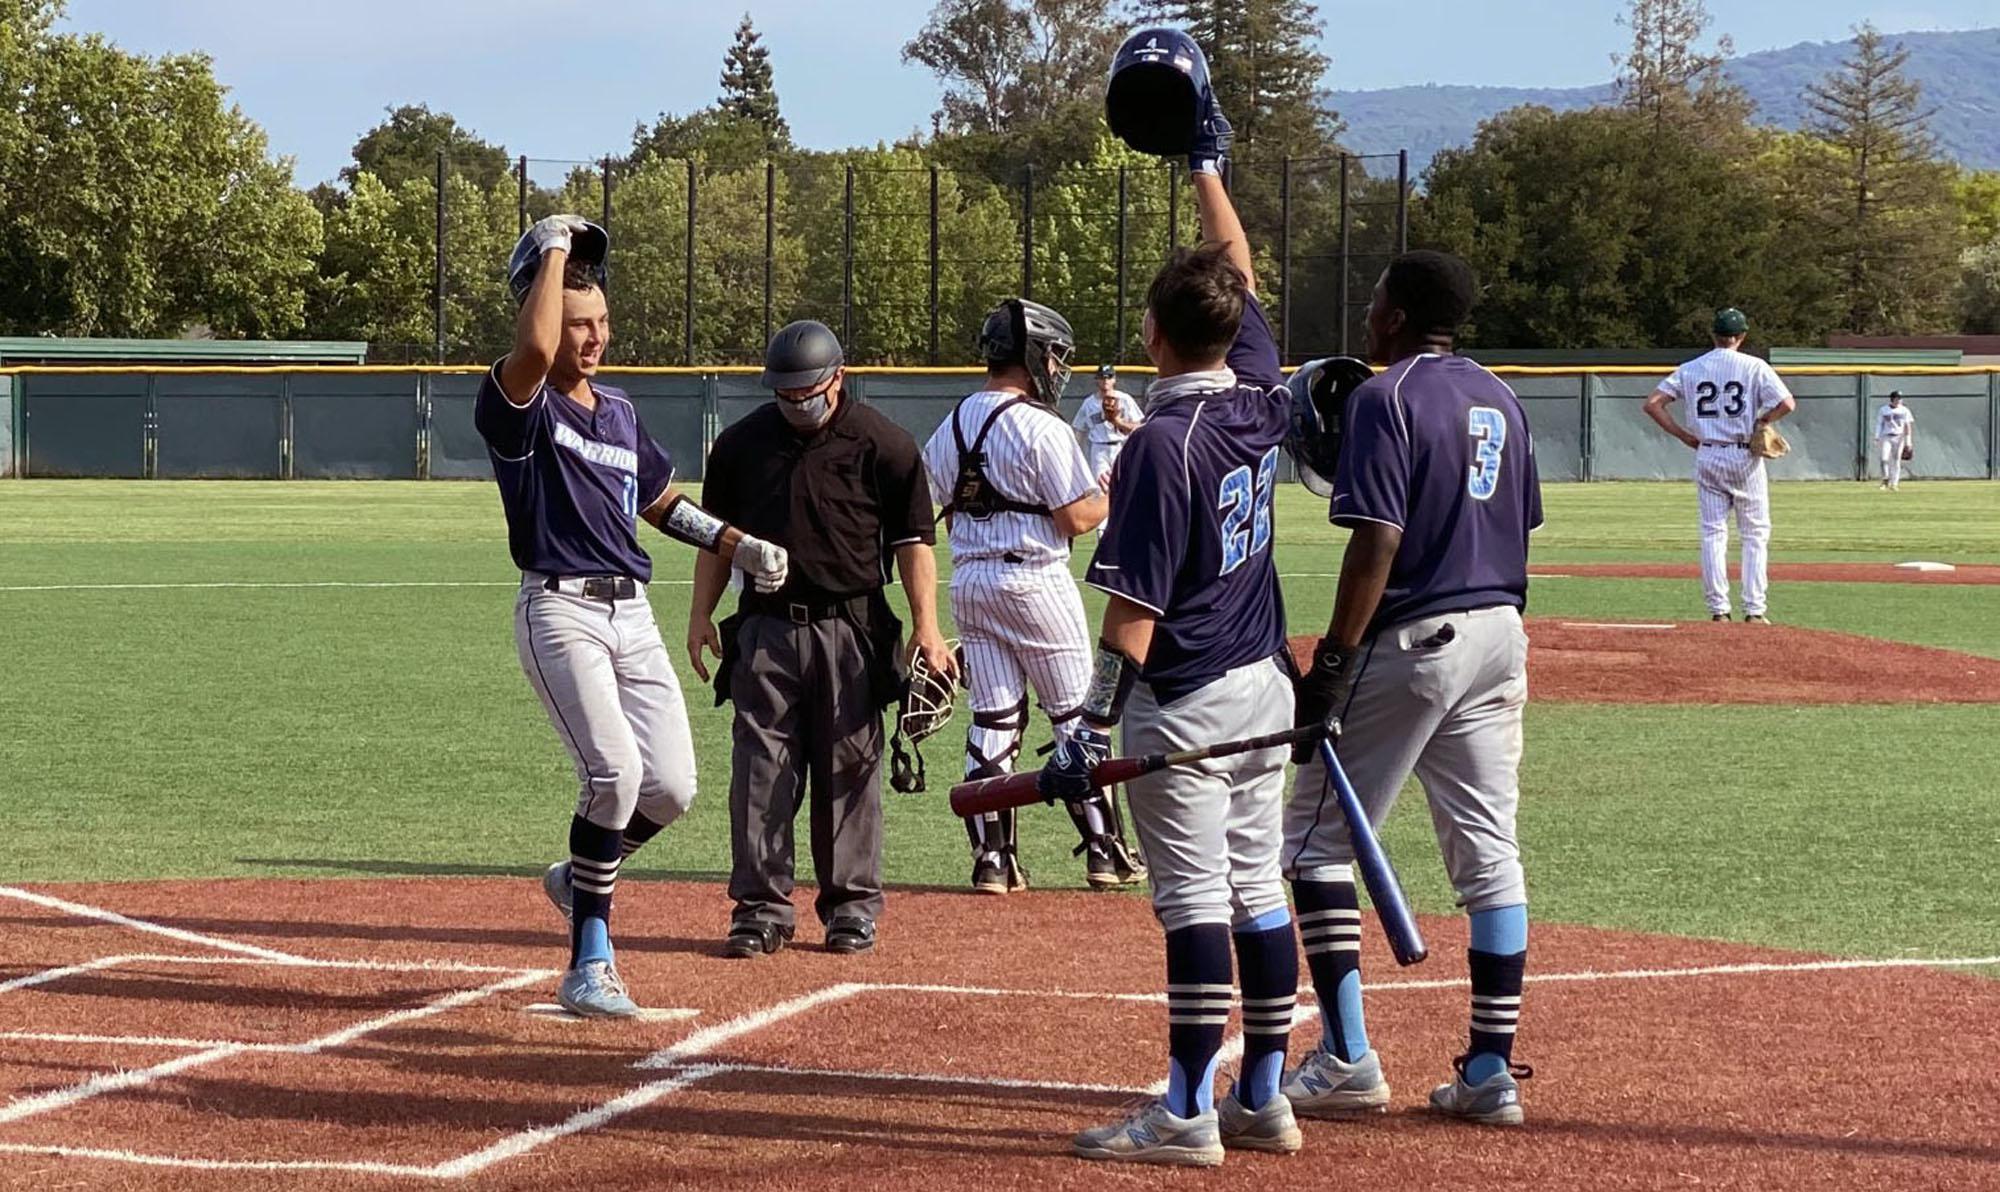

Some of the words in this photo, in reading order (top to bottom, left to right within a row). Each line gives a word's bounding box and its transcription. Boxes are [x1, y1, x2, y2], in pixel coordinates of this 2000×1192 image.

[1696, 381, 1746, 418] 23
[1468, 407, 1507, 500] 3
[1218, 445, 1279, 577] 22
